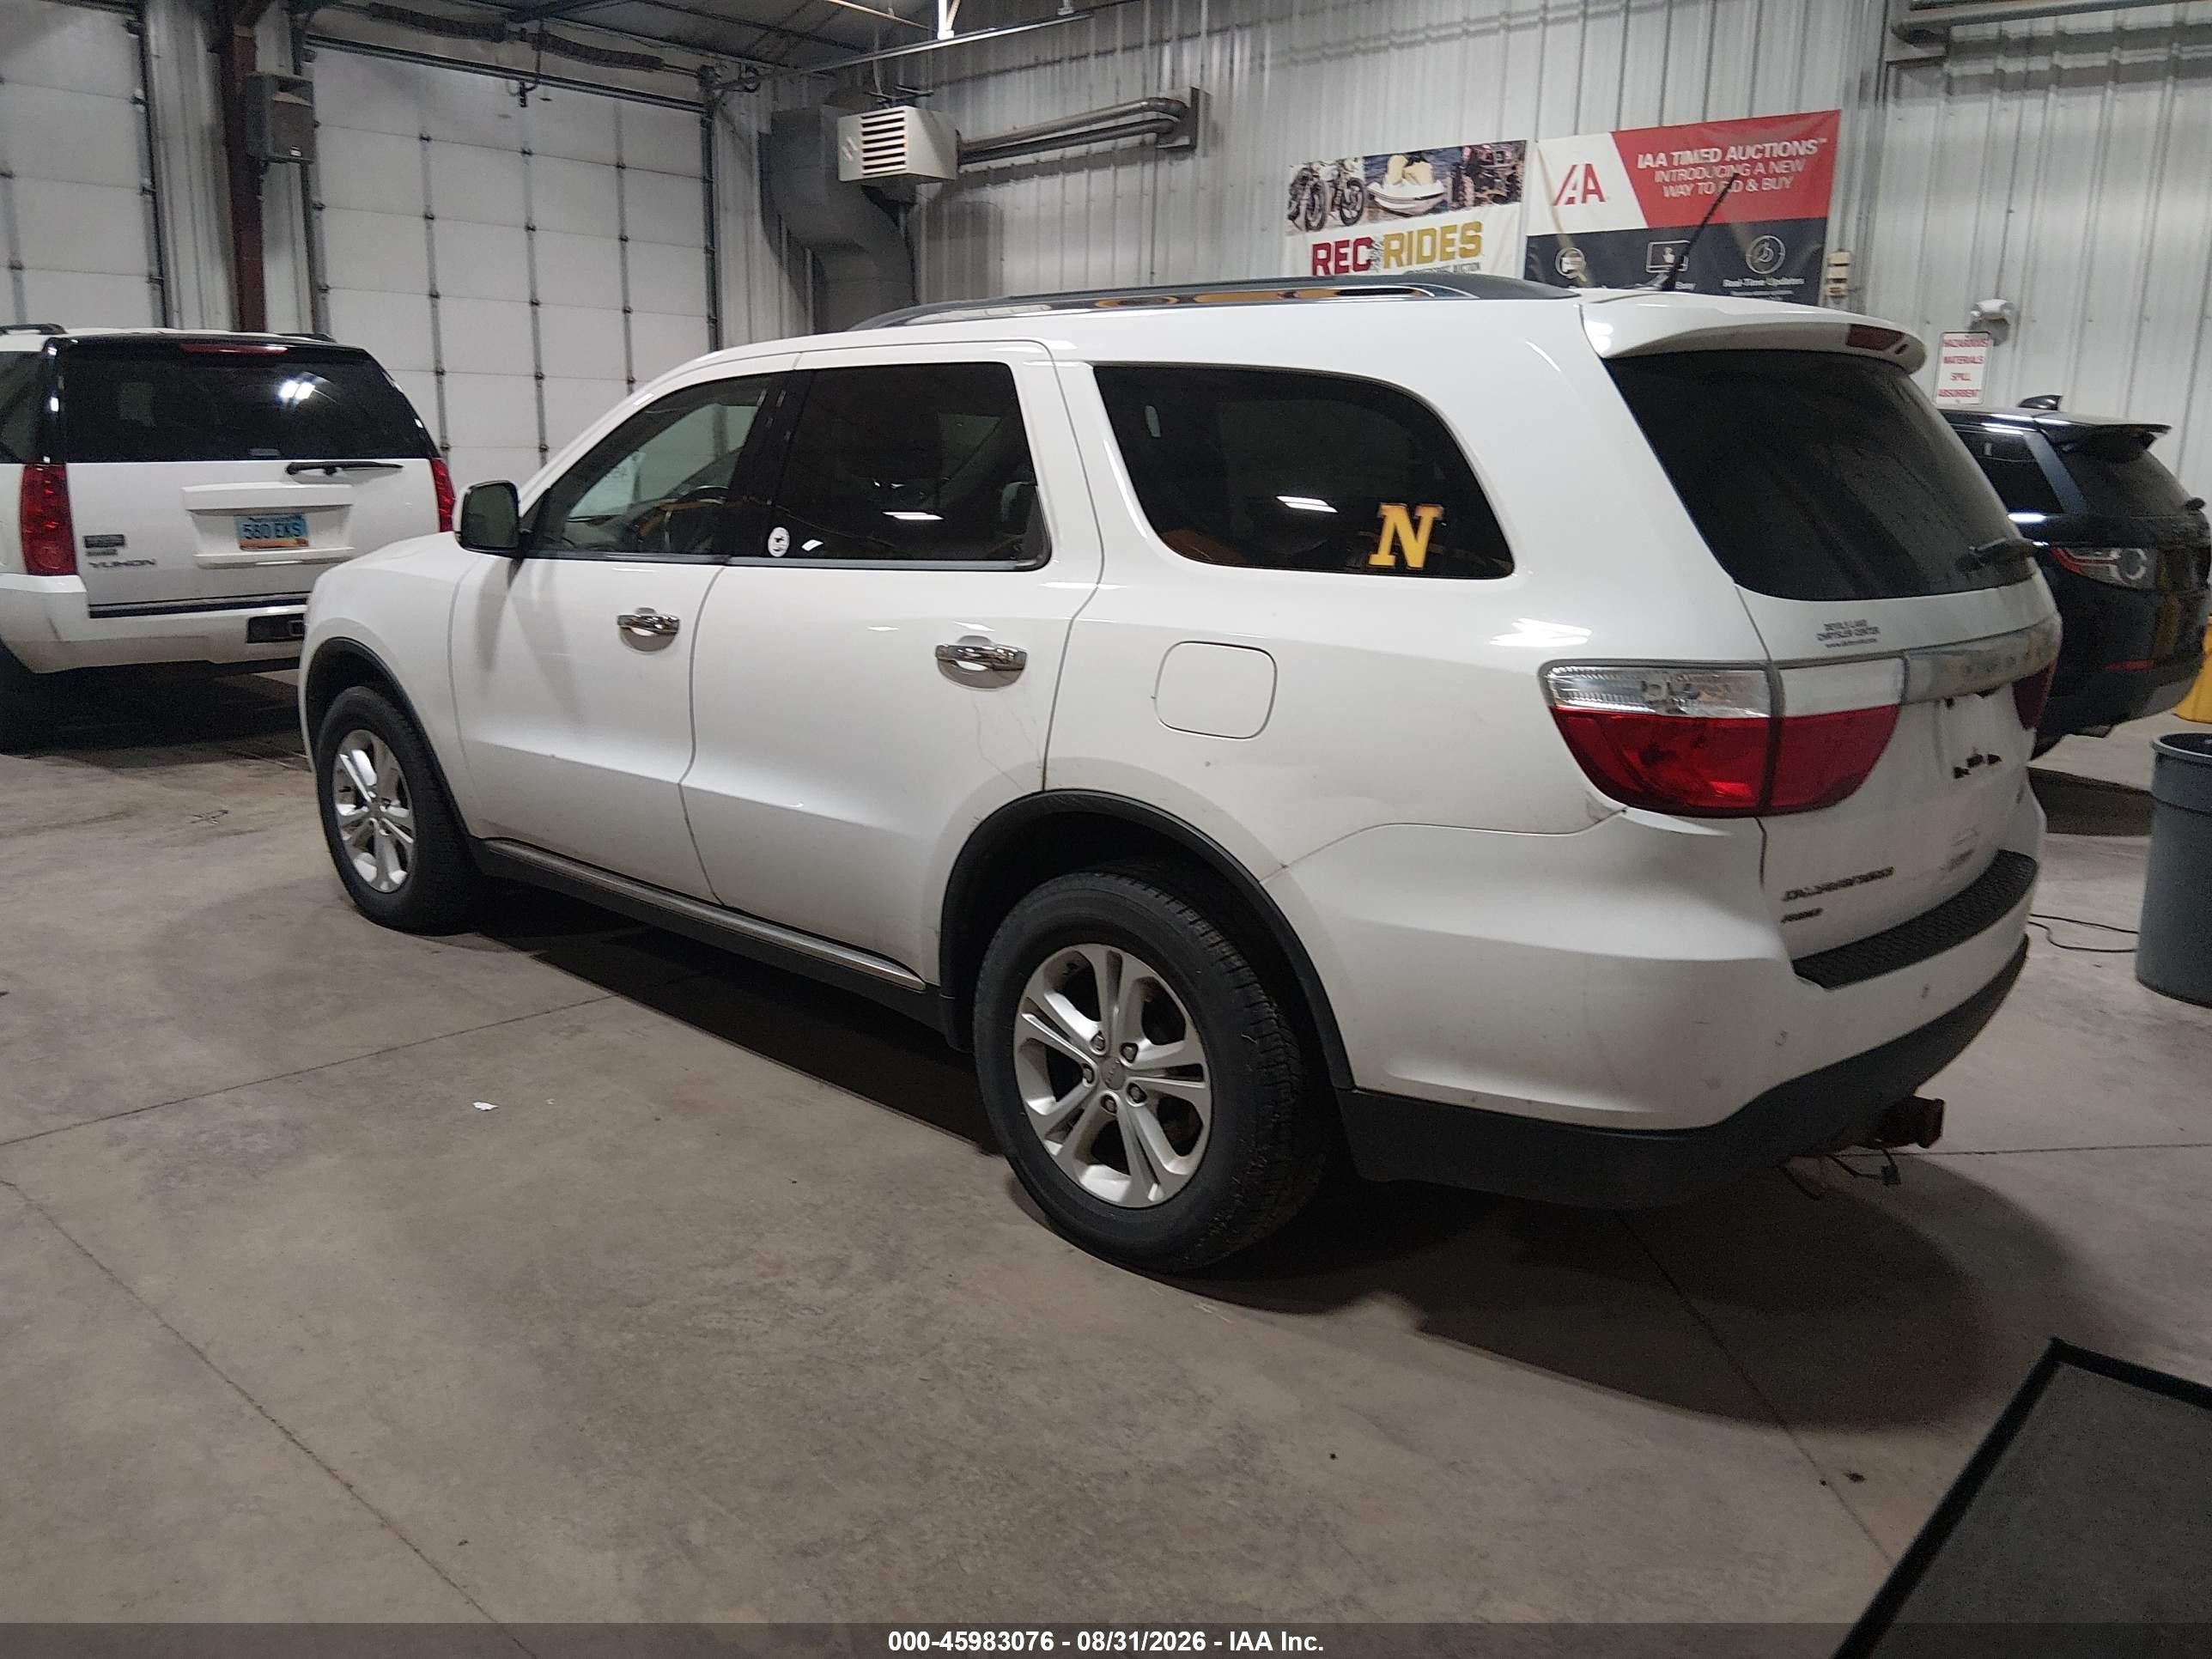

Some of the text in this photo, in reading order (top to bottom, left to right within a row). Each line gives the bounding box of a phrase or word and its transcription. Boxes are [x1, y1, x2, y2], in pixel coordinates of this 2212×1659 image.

[1637, 152, 1667, 169] IAA
[1670, 147, 1723, 167] TIMED
[1753, 161, 1766, 175] A
[1769, 159, 1807, 174] NEW
[1662, 183, 1694, 198] WAY
[1696, 180, 1717, 195] TO
[1745, 178, 1759, 192] &
[1761, 176, 1795, 191] BUY
[1311, 220, 1484, 276] REC RIDES
[1943, 356, 1984, 365] MATERIALS
[1368, 502, 1444, 570] N
